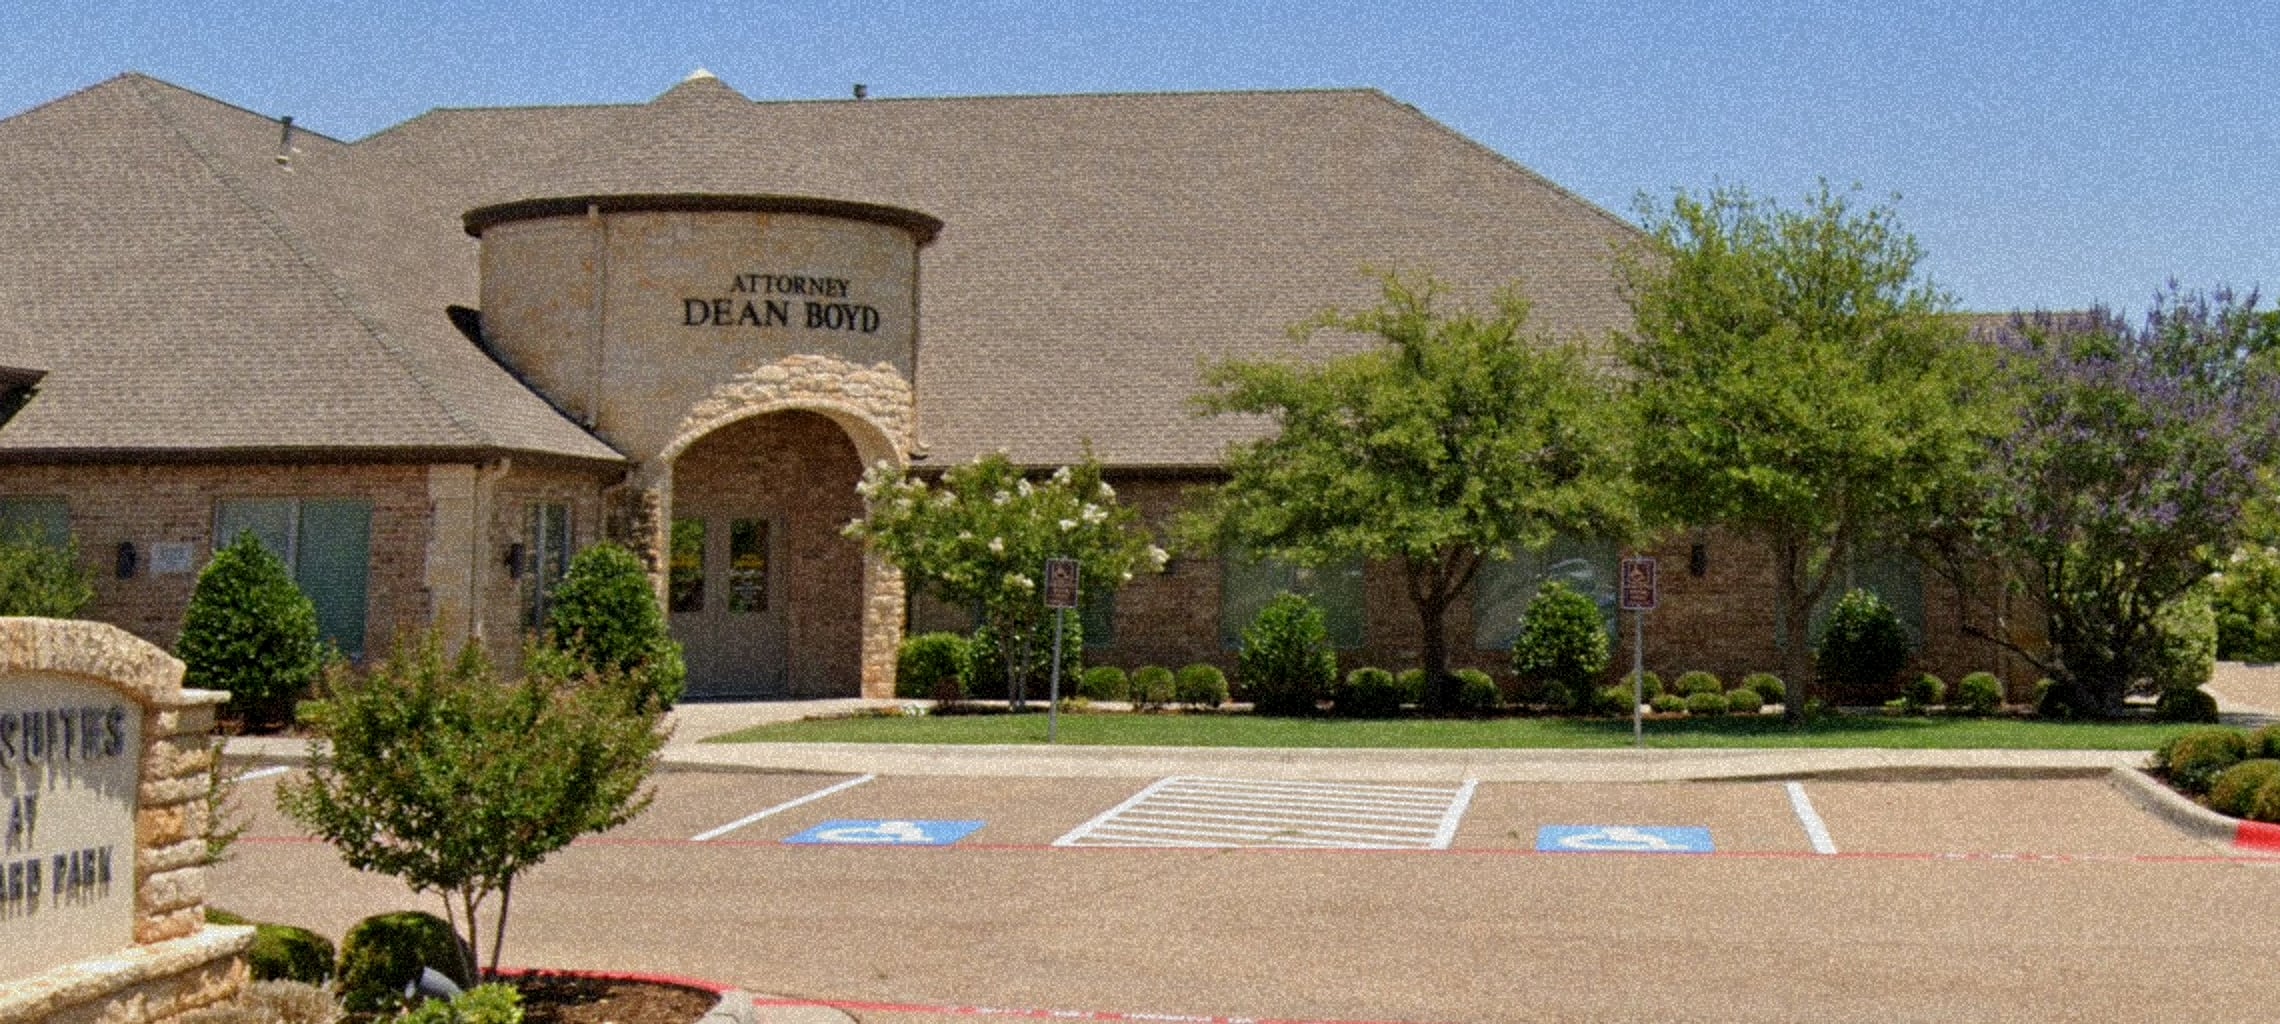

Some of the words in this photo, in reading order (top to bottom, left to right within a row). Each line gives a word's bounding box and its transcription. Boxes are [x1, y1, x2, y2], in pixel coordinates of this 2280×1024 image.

[730, 273, 851, 297] ATTORNEY
[683, 298, 790, 327] DEAN
[804, 301, 880, 333] BOYD
[53, 846, 113, 895] PARK
